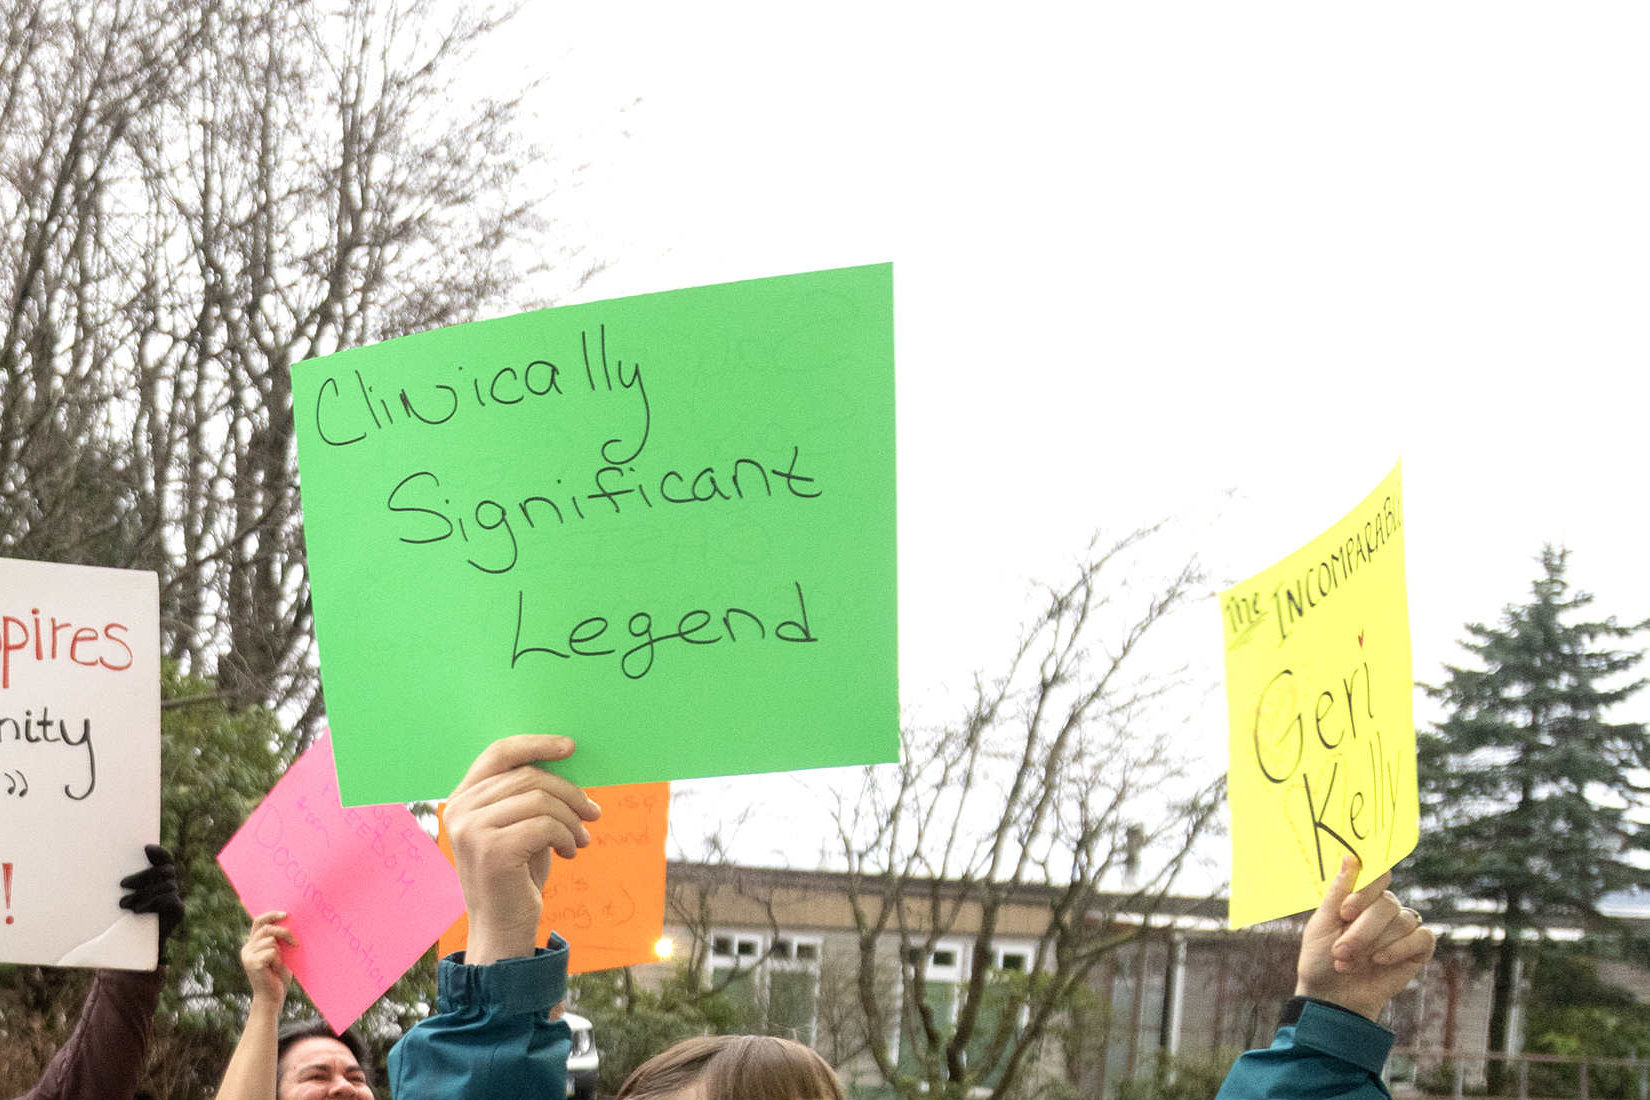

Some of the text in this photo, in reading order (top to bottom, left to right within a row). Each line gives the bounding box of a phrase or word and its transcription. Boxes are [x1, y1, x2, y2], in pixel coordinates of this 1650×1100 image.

[316, 324, 650, 465] Clinically
[387, 446, 823, 574] Significant
[511, 582, 818, 679] Legend
[1254, 629, 1374, 784] Geri
[1303, 730, 1401, 882] Kelly
[256, 803, 386, 989] Documentation
